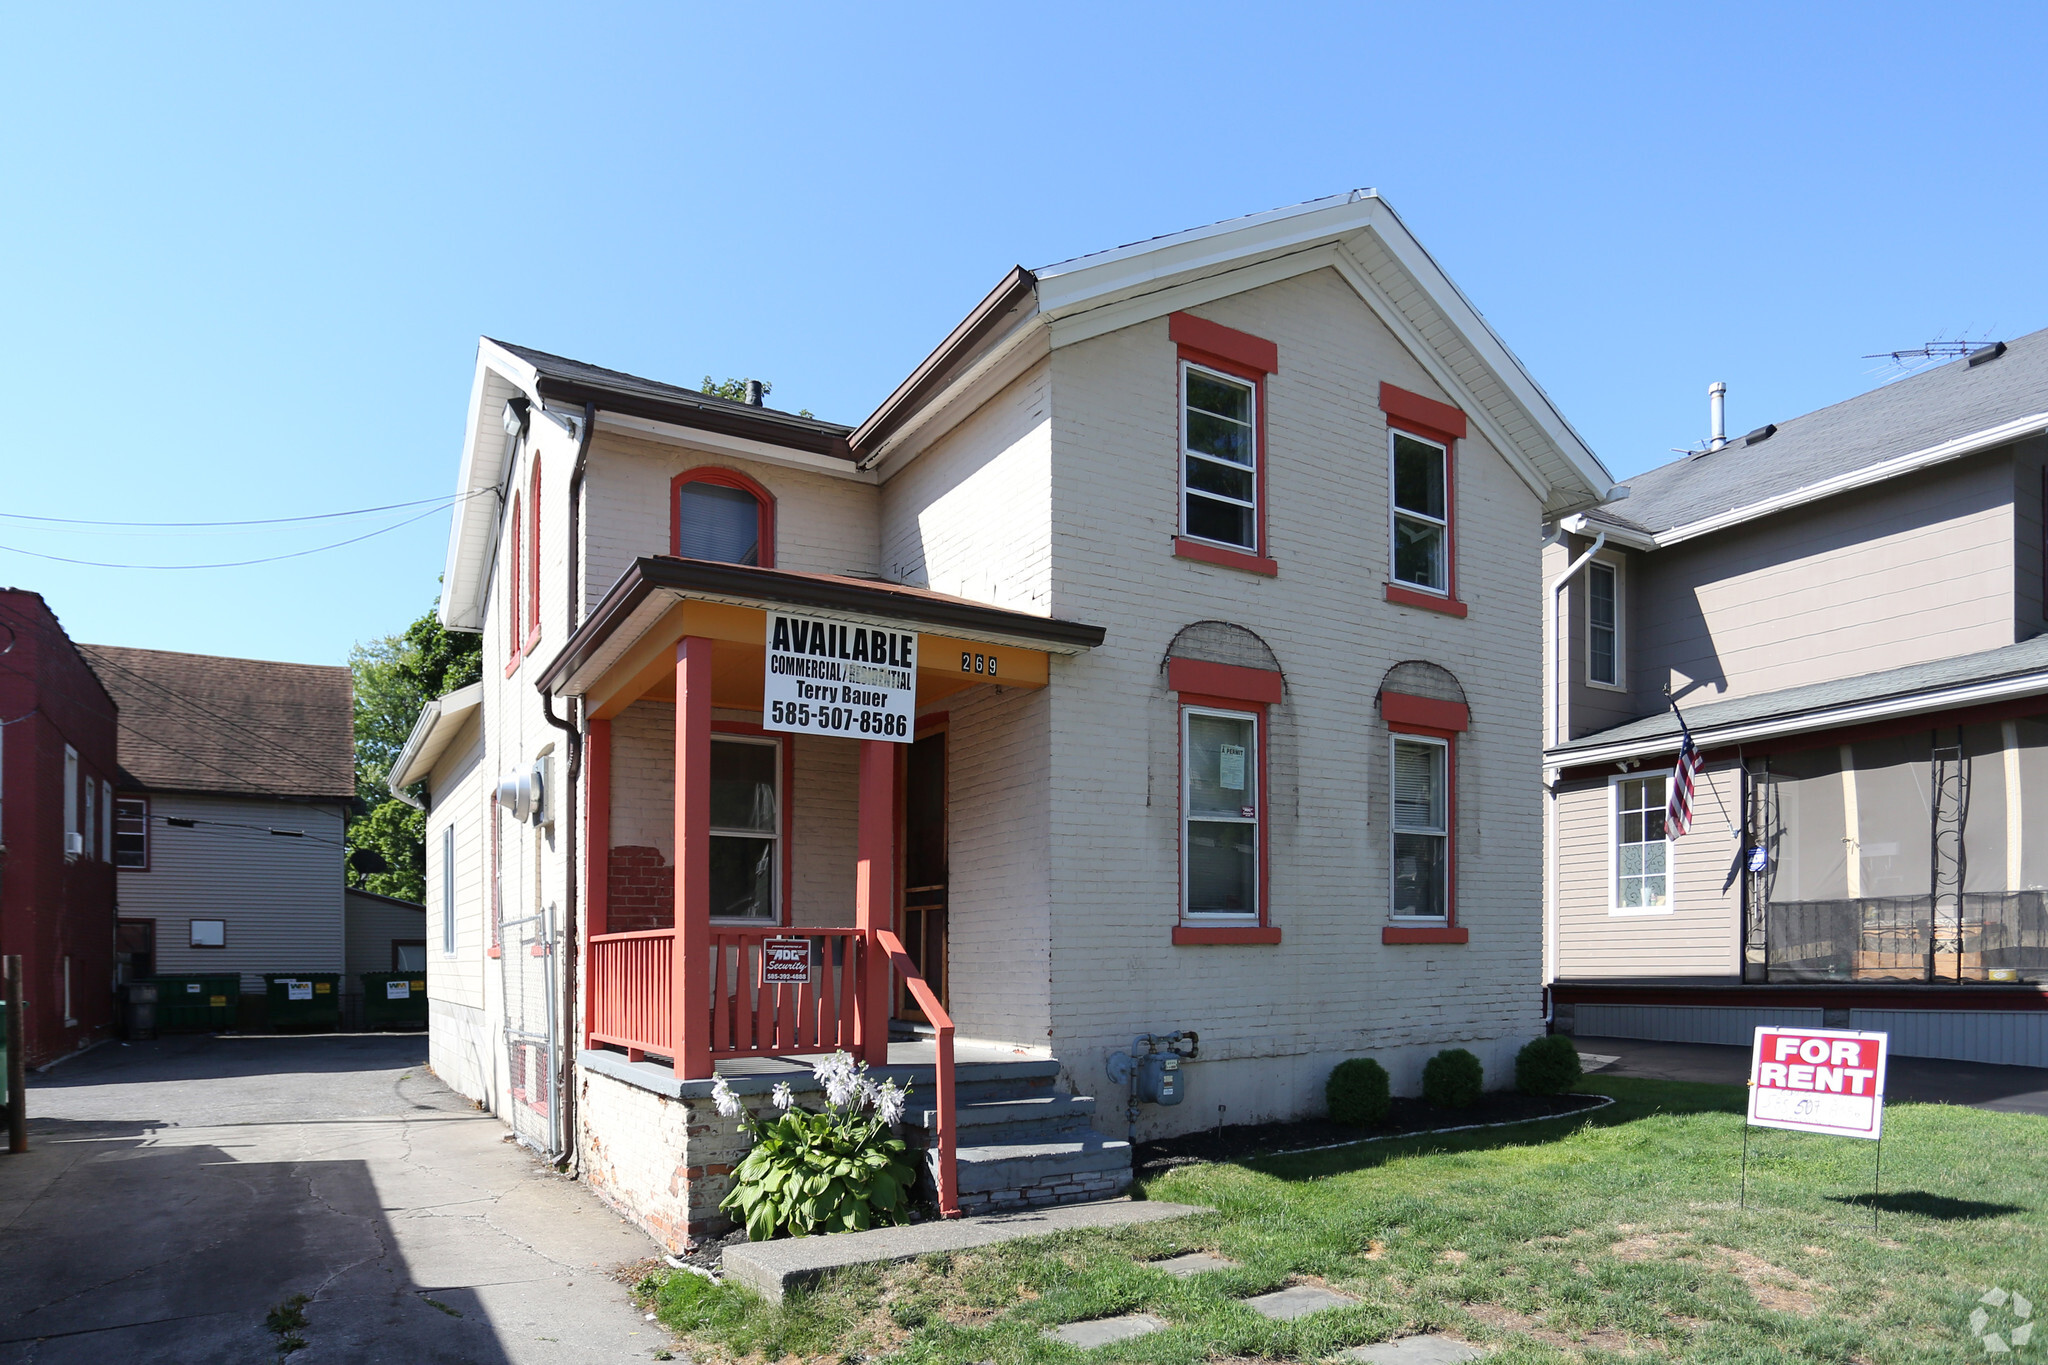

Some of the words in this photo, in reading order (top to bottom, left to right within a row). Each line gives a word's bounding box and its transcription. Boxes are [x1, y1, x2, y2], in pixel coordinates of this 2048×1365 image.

[772, 617, 913, 668] AVAILABLE
[963, 654, 996, 674] 269
[796, 679, 838, 703] Terry
[842, 685, 888, 708] Bauer
[772, 700, 907, 737] 585-507-8586
[767, 960, 808, 973] Security
[1775, 1037, 1861, 1067] FOR
[1760, 1062, 1874, 1095] RENT
